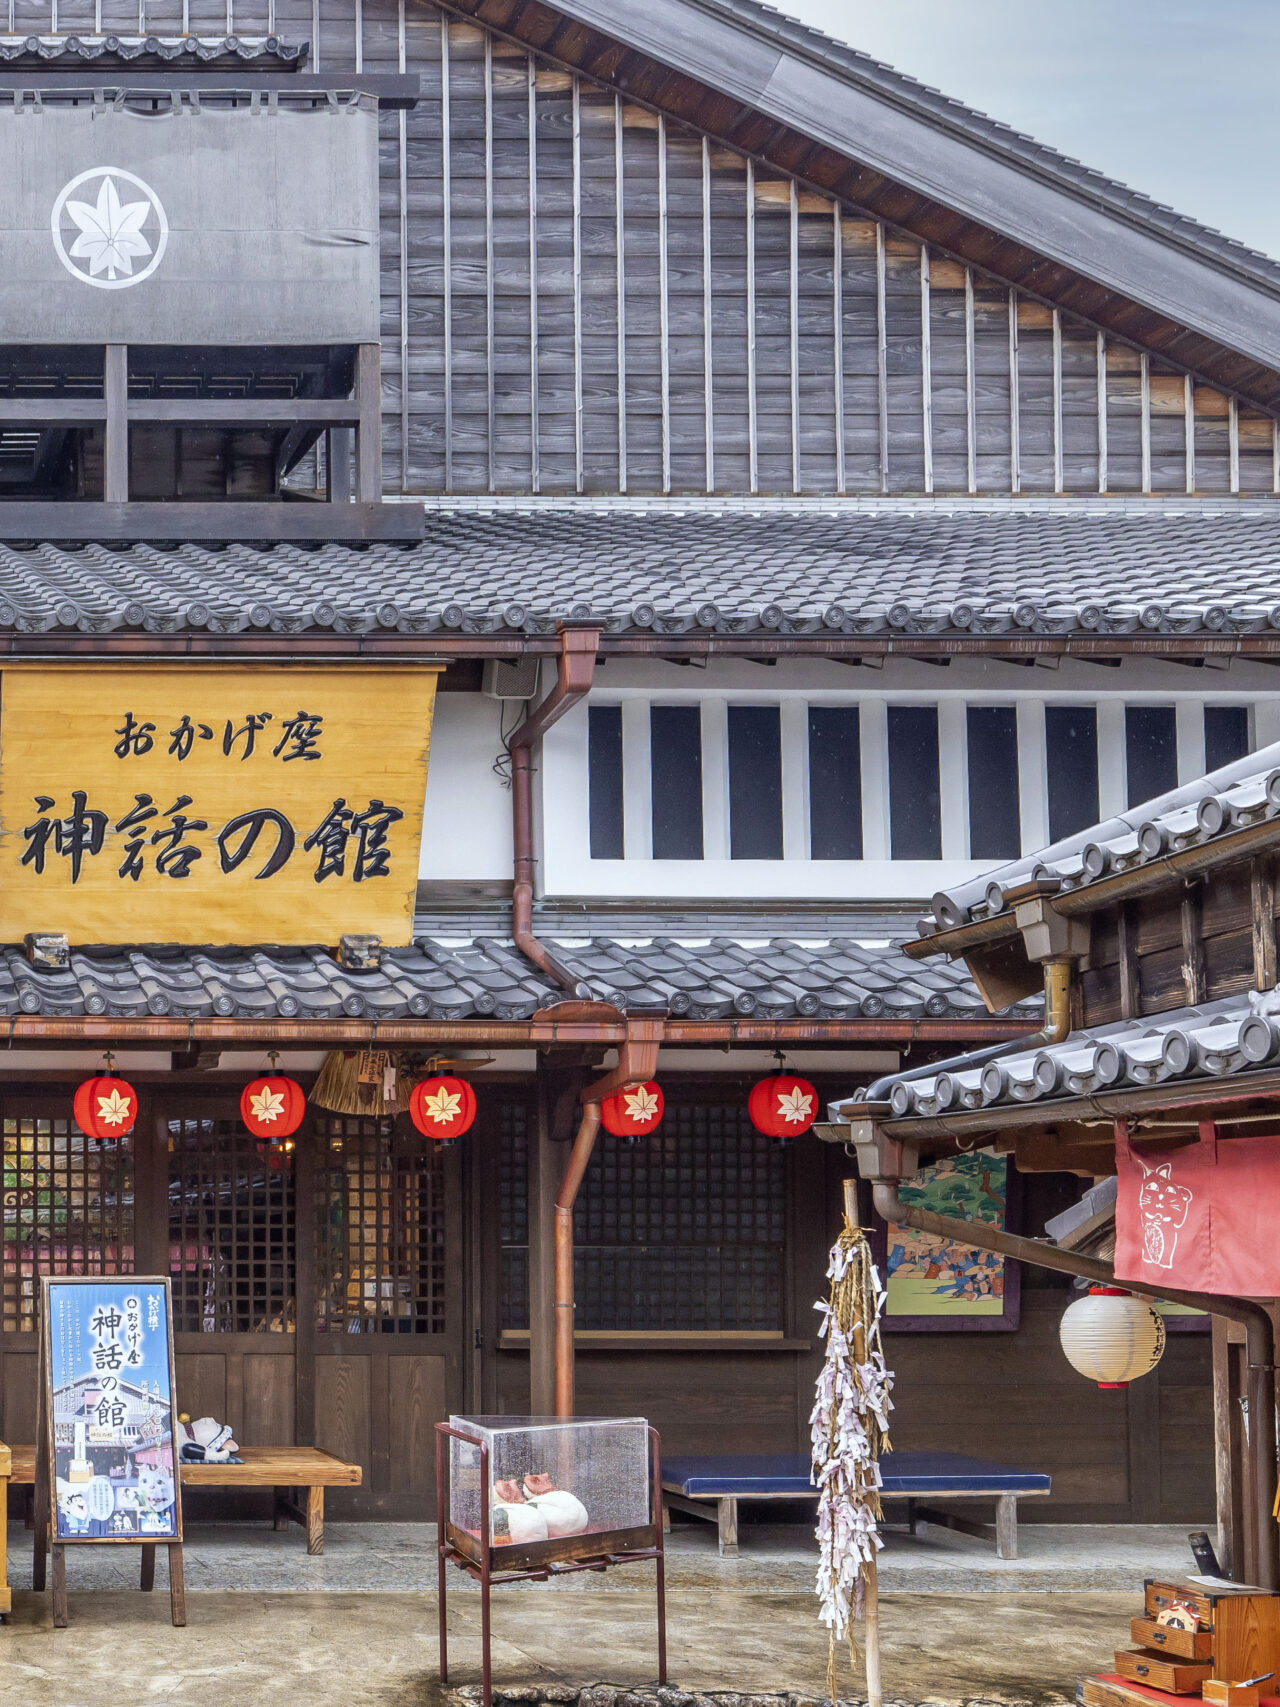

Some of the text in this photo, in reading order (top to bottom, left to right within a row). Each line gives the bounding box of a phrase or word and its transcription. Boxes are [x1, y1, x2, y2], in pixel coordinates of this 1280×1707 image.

[114, 711, 324, 762] おかげ座
[21, 790, 404, 885] 神話の館
[92, 1307, 127, 1427] 神話の館
[127, 1312, 141, 1365] おかげ座
